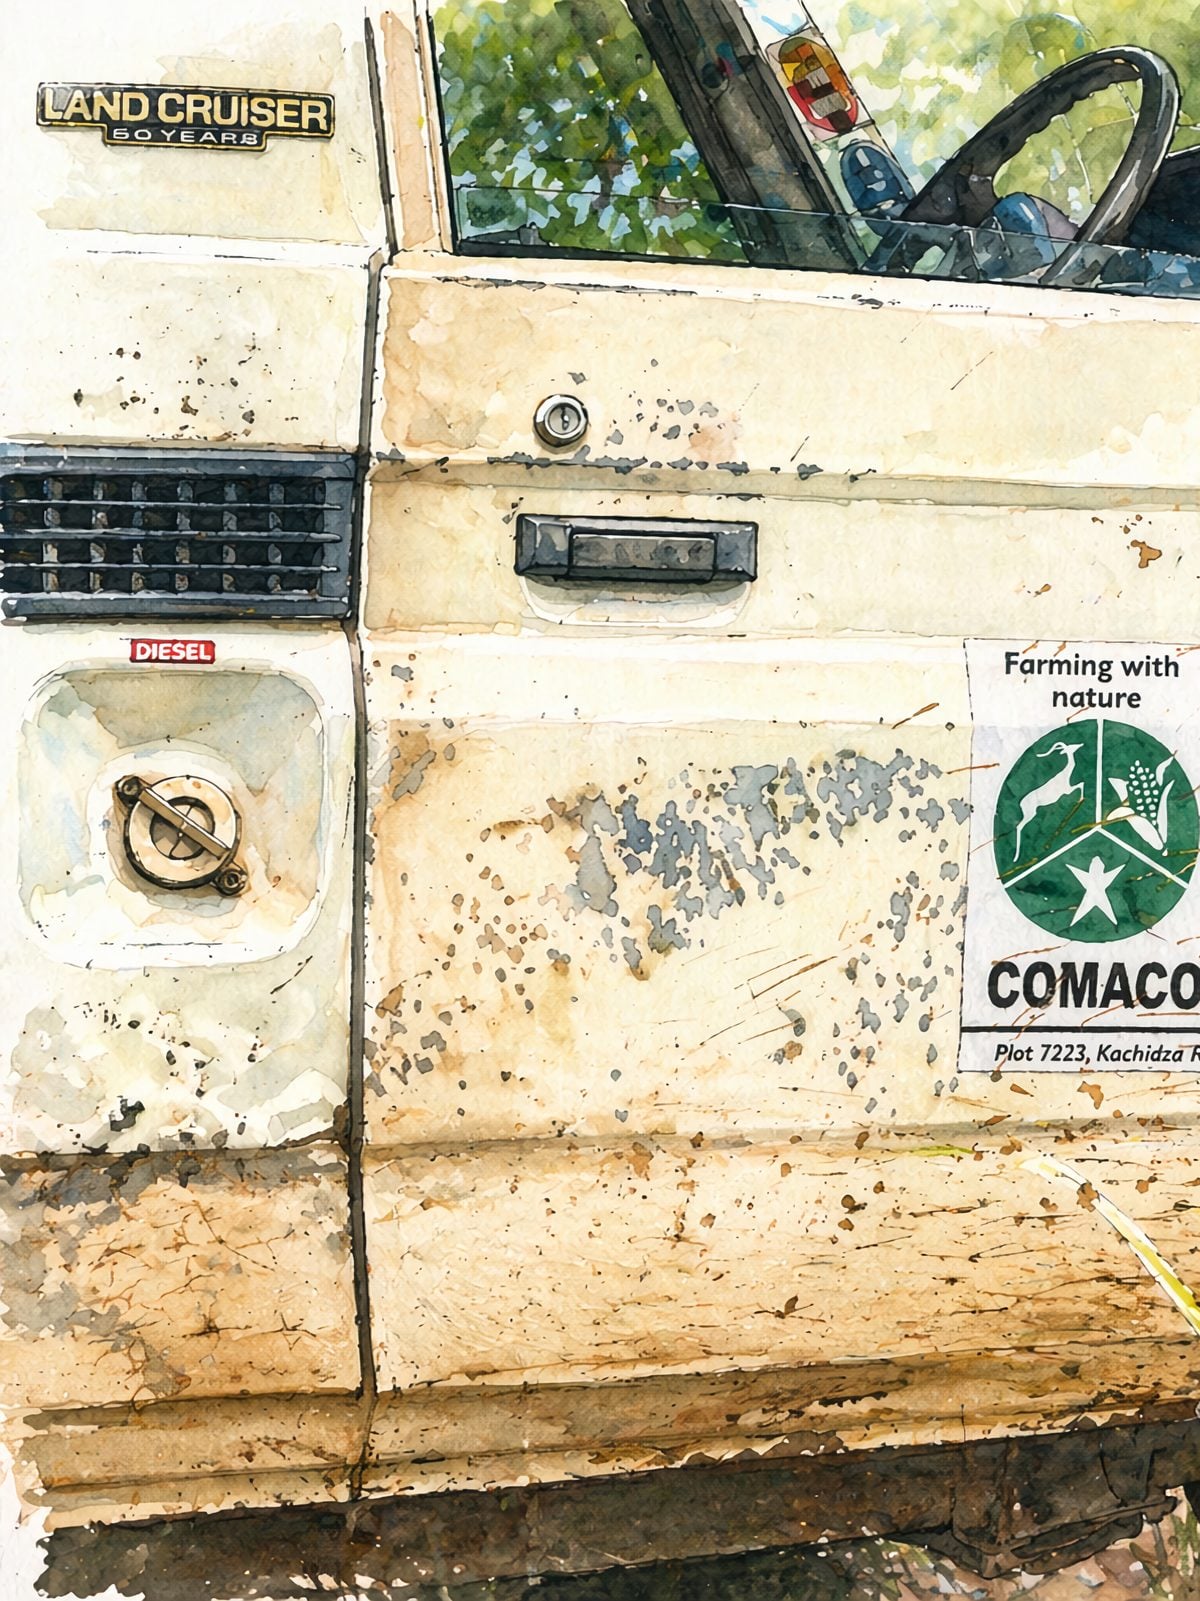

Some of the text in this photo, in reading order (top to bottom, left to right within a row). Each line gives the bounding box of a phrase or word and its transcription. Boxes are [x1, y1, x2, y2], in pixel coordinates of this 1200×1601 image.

[45, 89, 328, 131] LAND CRUISER
[161, 129, 259, 146] YEARS
[135, 642, 212, 661] DIESEL
[1004, 651, 1179, 683] Farming with
[1052, 688, 1142, 709] nature
[995, 1044, 1034, 1062] Plot
[1041, 1044, 1091, 1064] 7223,
[1096, 1044, 1184, 1063] Kachidza
